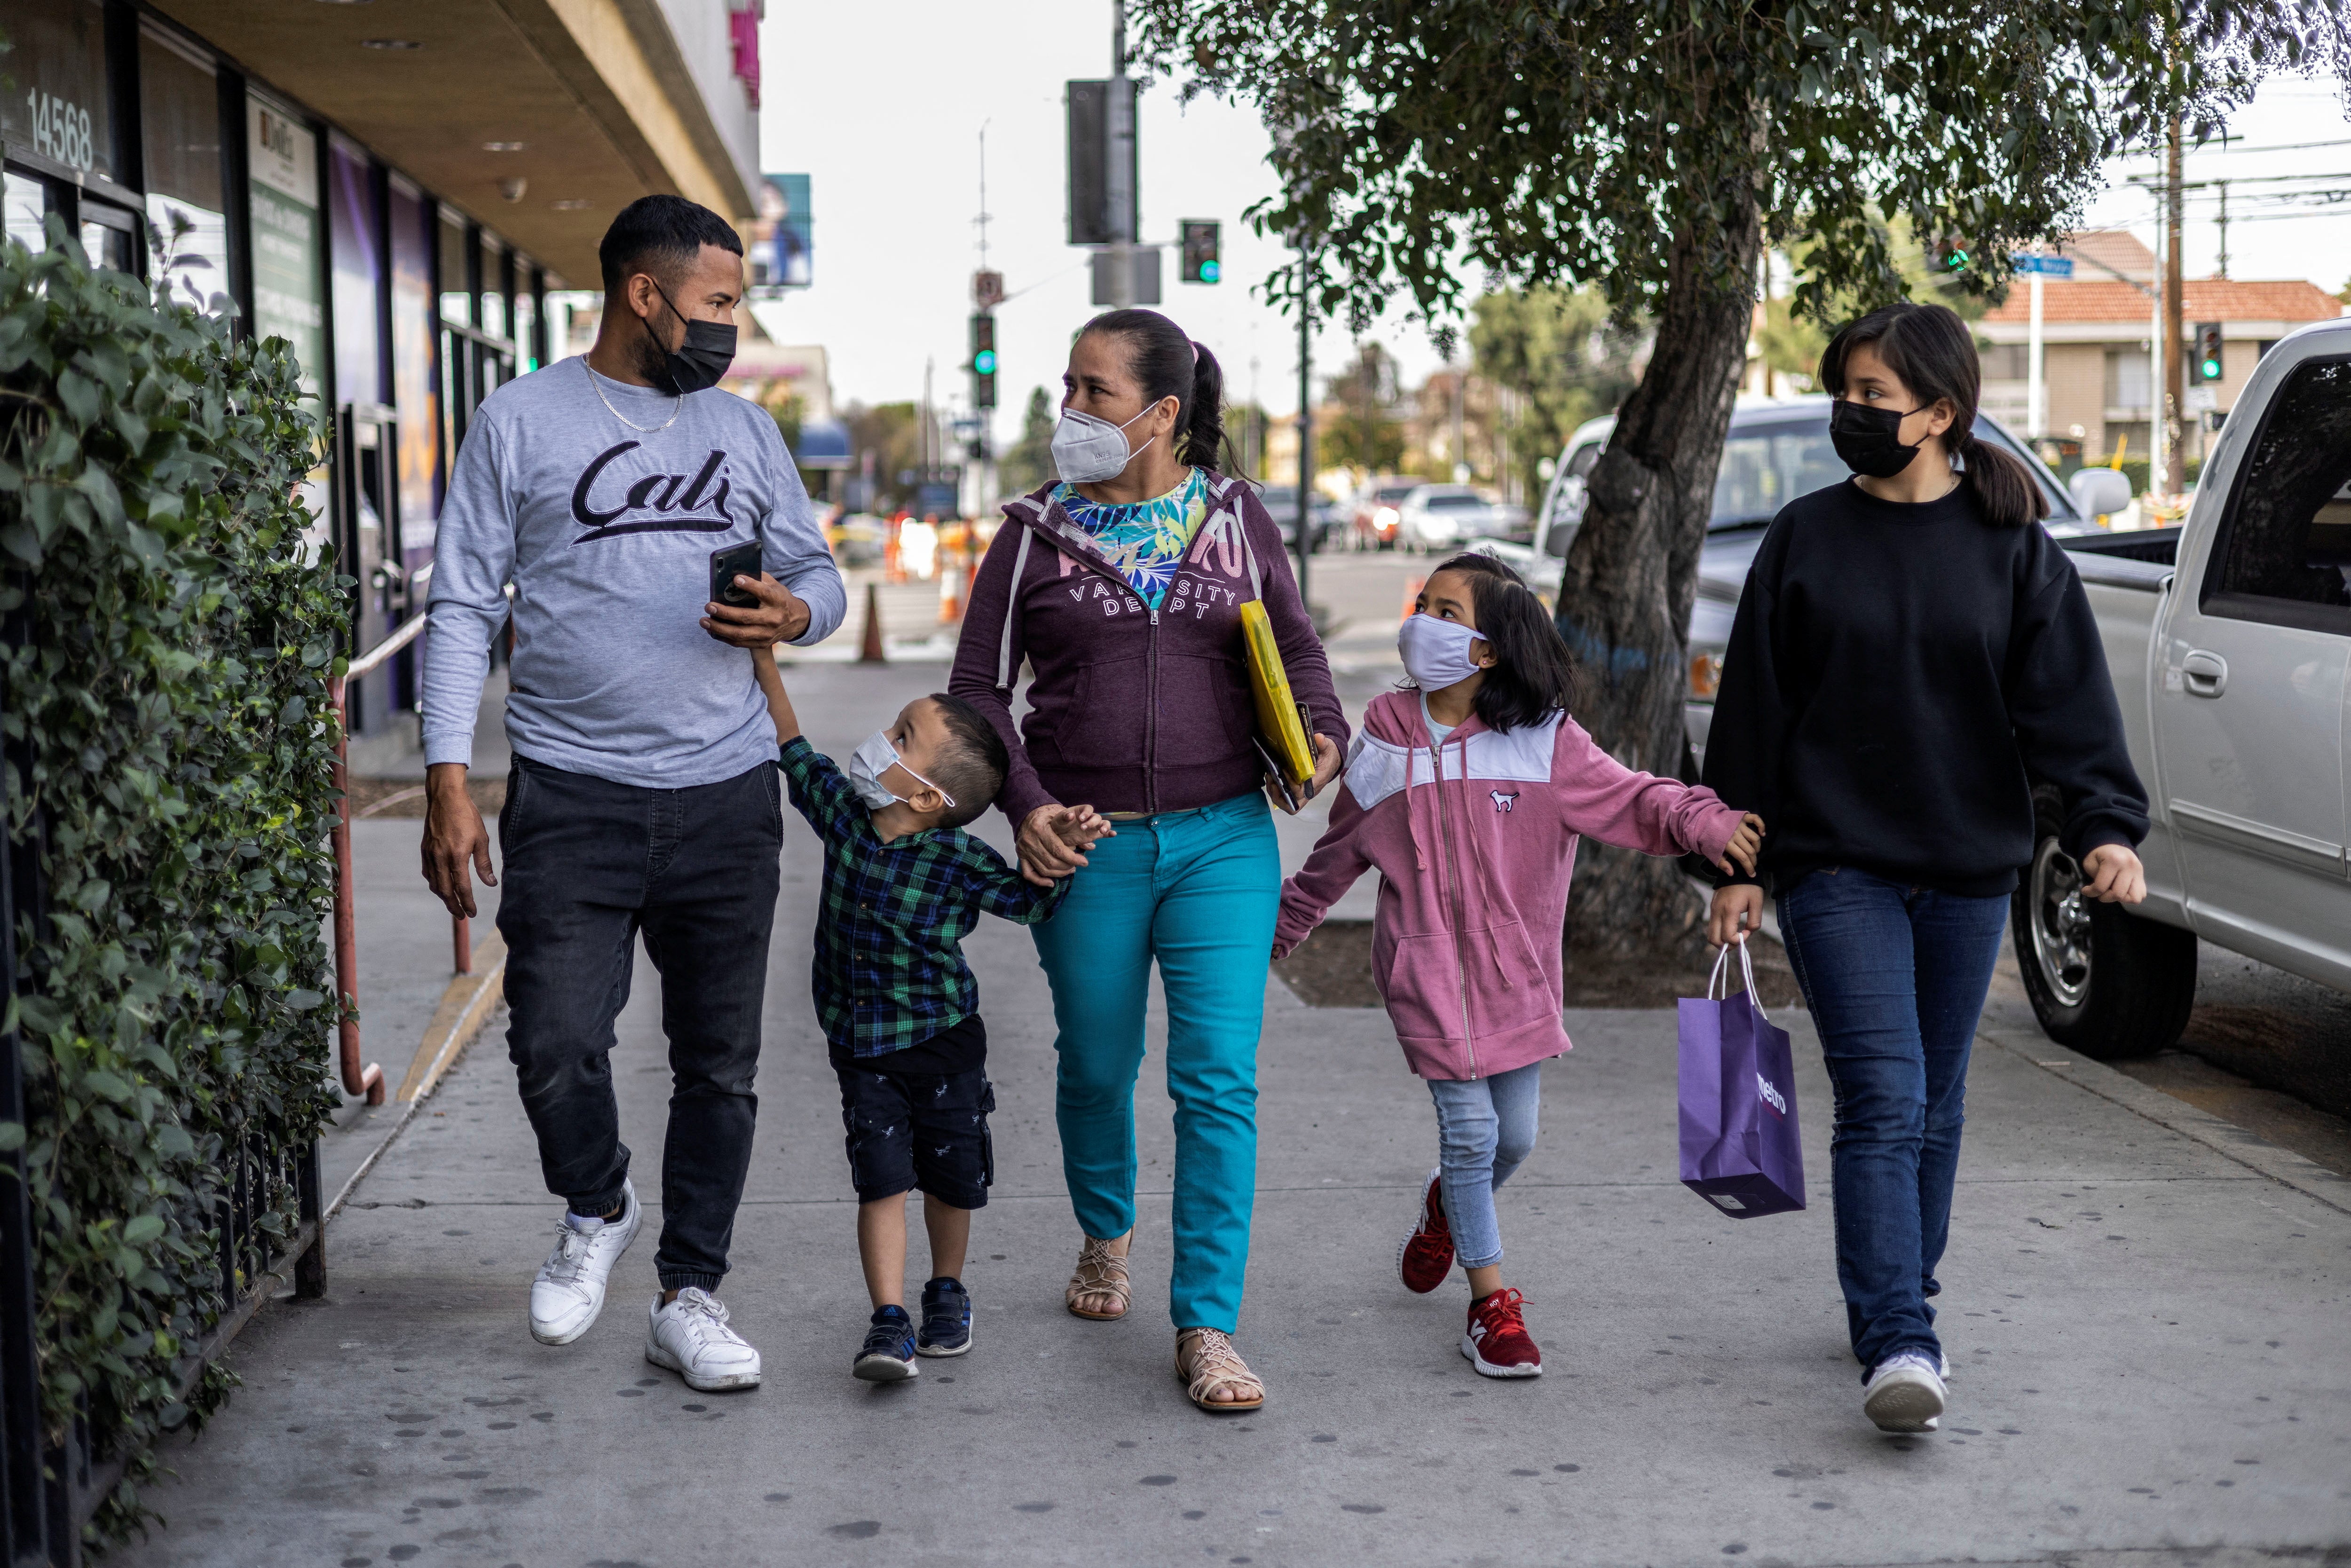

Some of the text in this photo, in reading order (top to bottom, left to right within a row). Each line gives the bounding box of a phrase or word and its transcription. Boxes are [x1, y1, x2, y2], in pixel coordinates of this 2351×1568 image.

[27, 87, 93, 172] 14568
[1094, 451, 1110, 460] KN95
[569, 439, 735, 541] Cali
[1103, 597, 1209, 619] DEPT
[1757, 1072, 1786, 1115] metro
